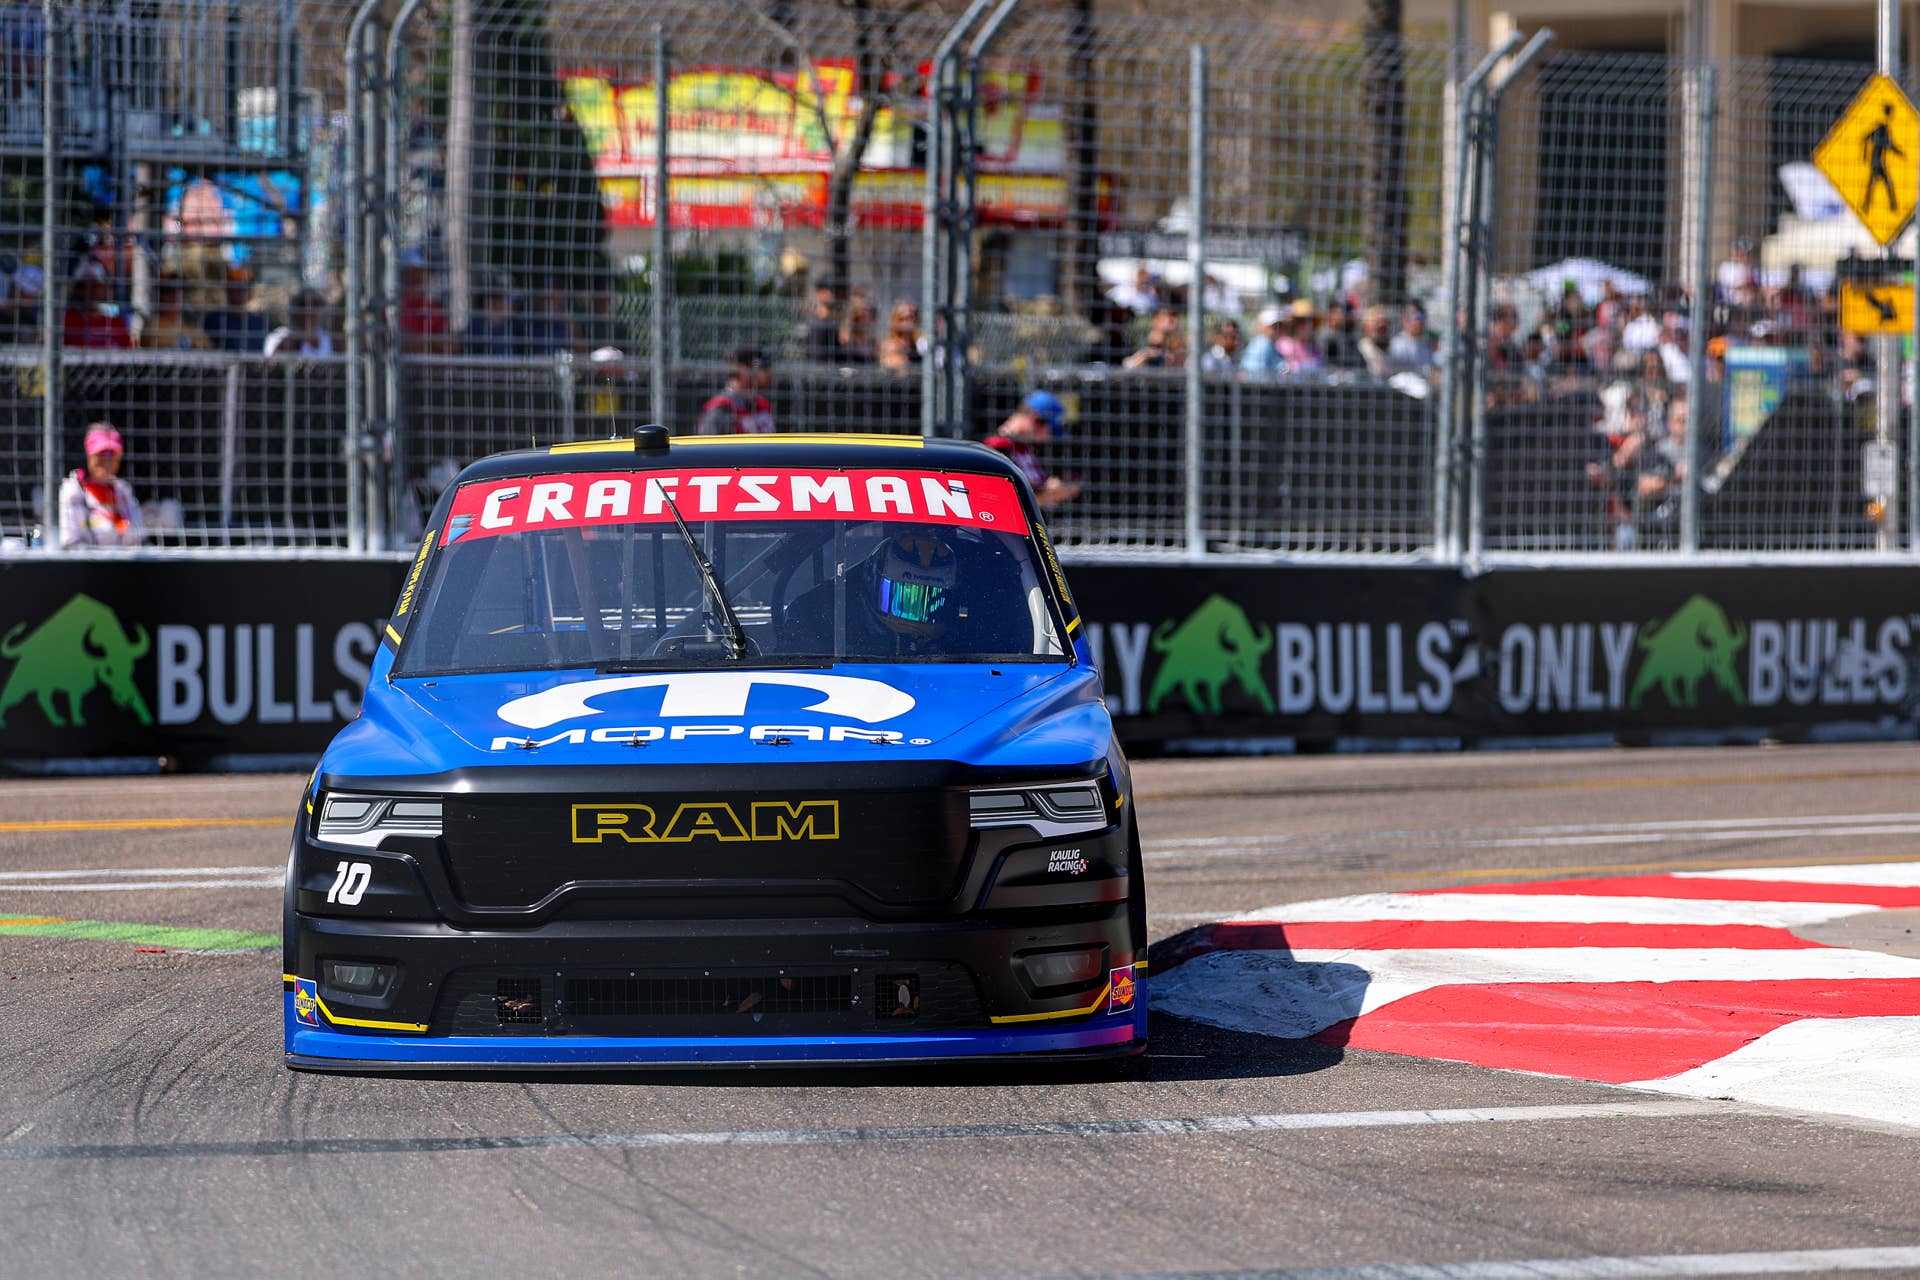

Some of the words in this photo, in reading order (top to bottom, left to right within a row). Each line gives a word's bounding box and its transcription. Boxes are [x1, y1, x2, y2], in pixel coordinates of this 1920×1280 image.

[157, 620, 378, 725] BULLS
[1277, 620, 1454, 715] BULLS
[1500, 622, 1639, 713] ONLY
[572, 800, 839, 843] RAM
[1048, 860, 1079, 872] RACING
[1050, 849, 1080, 861] KAULIG
[327, 861, 372, 905] 10
